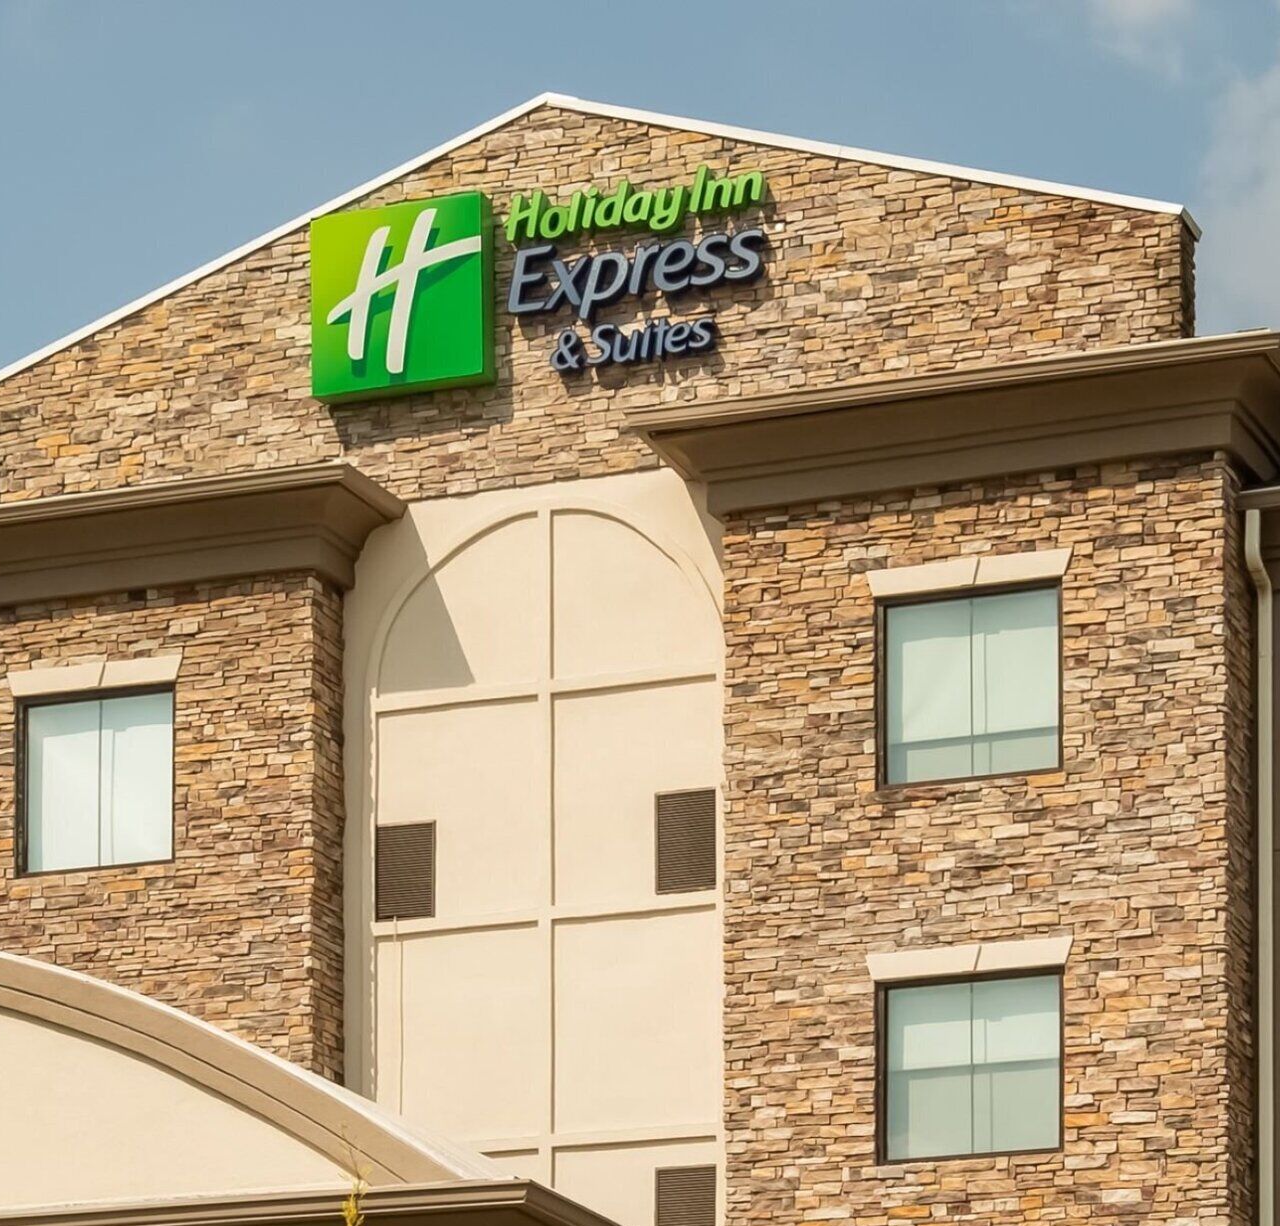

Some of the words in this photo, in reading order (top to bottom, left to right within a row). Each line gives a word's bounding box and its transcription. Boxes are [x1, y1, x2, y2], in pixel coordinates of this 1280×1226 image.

[506, 181, 684, 241] Holiday
[689, 165, 766, 214] Inn
[506, 229, 766, 319] Express
[551, 329, 584, 372] &
[585, 318, 715, 365] Suites
